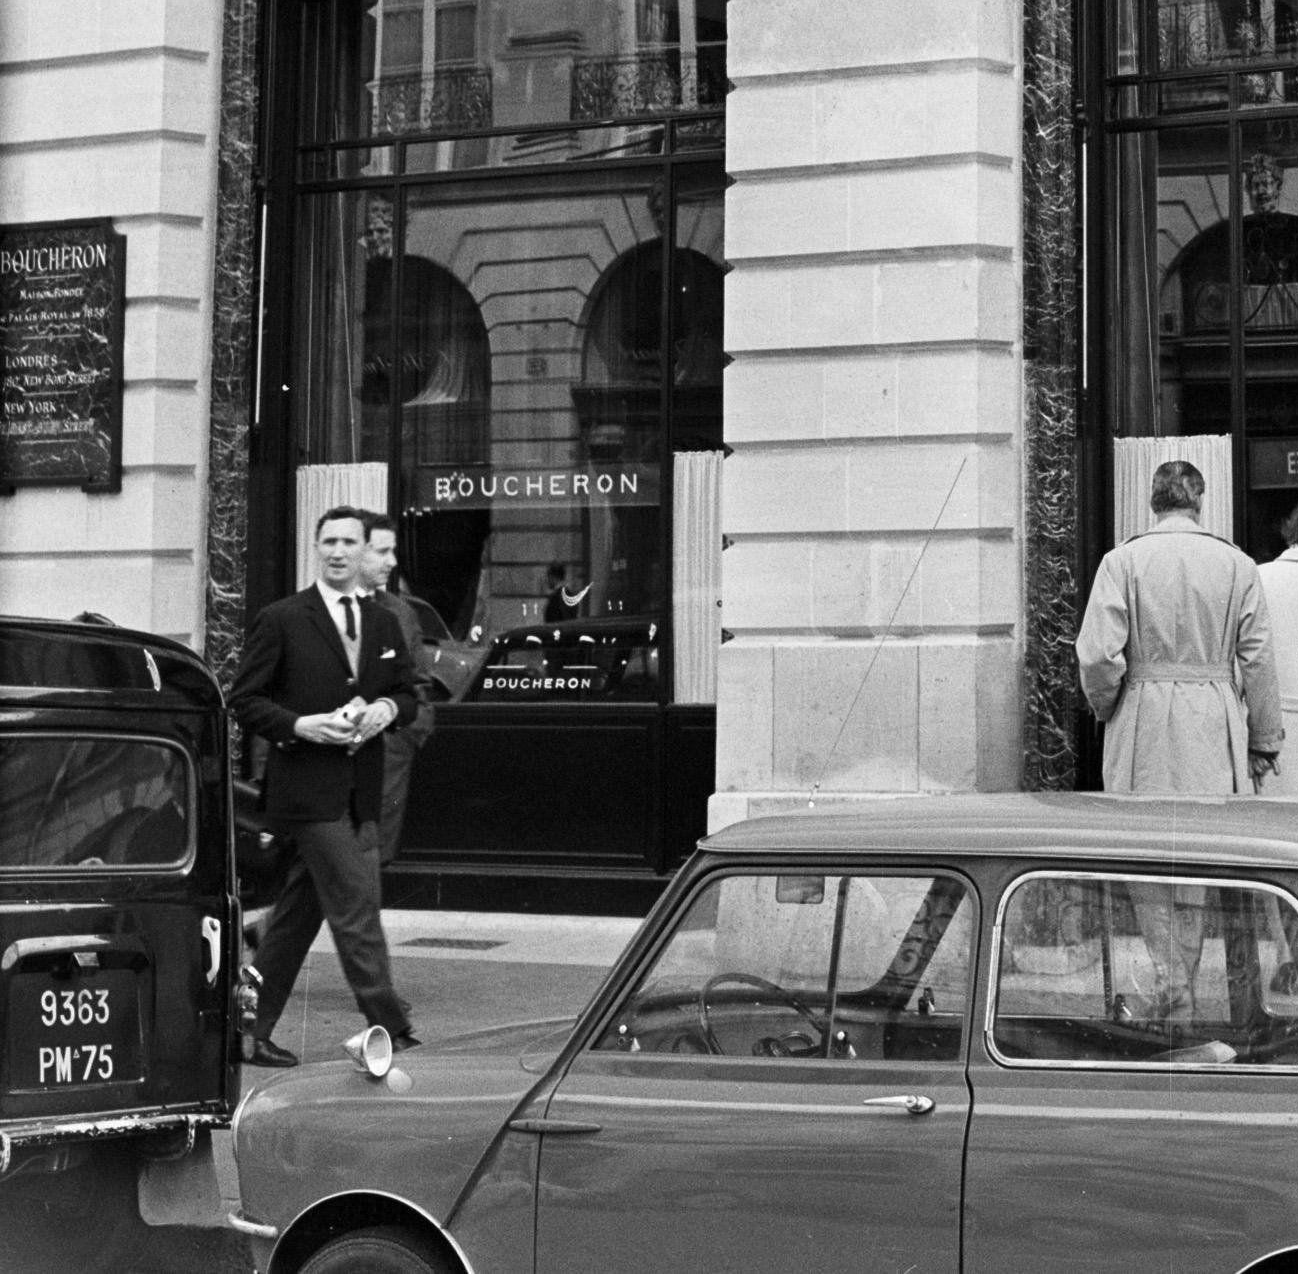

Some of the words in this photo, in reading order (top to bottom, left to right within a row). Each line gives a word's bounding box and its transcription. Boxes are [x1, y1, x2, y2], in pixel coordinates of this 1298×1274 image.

[1, 243, 107, 274] BOUCHERON
[5, 354, 58, 368] LONDRES
[4, 402, 24, 414] NEW
[28, 400, 56, 414] YORK
[434, 474, 639, 500] BOUCHERON
[483, 677, 592, 689] BOUCHERON
[40, 989, 110, 1026] 9363
[39, 1046, 72, 1083] PM
[81, 1044, 114, 1081] 75
